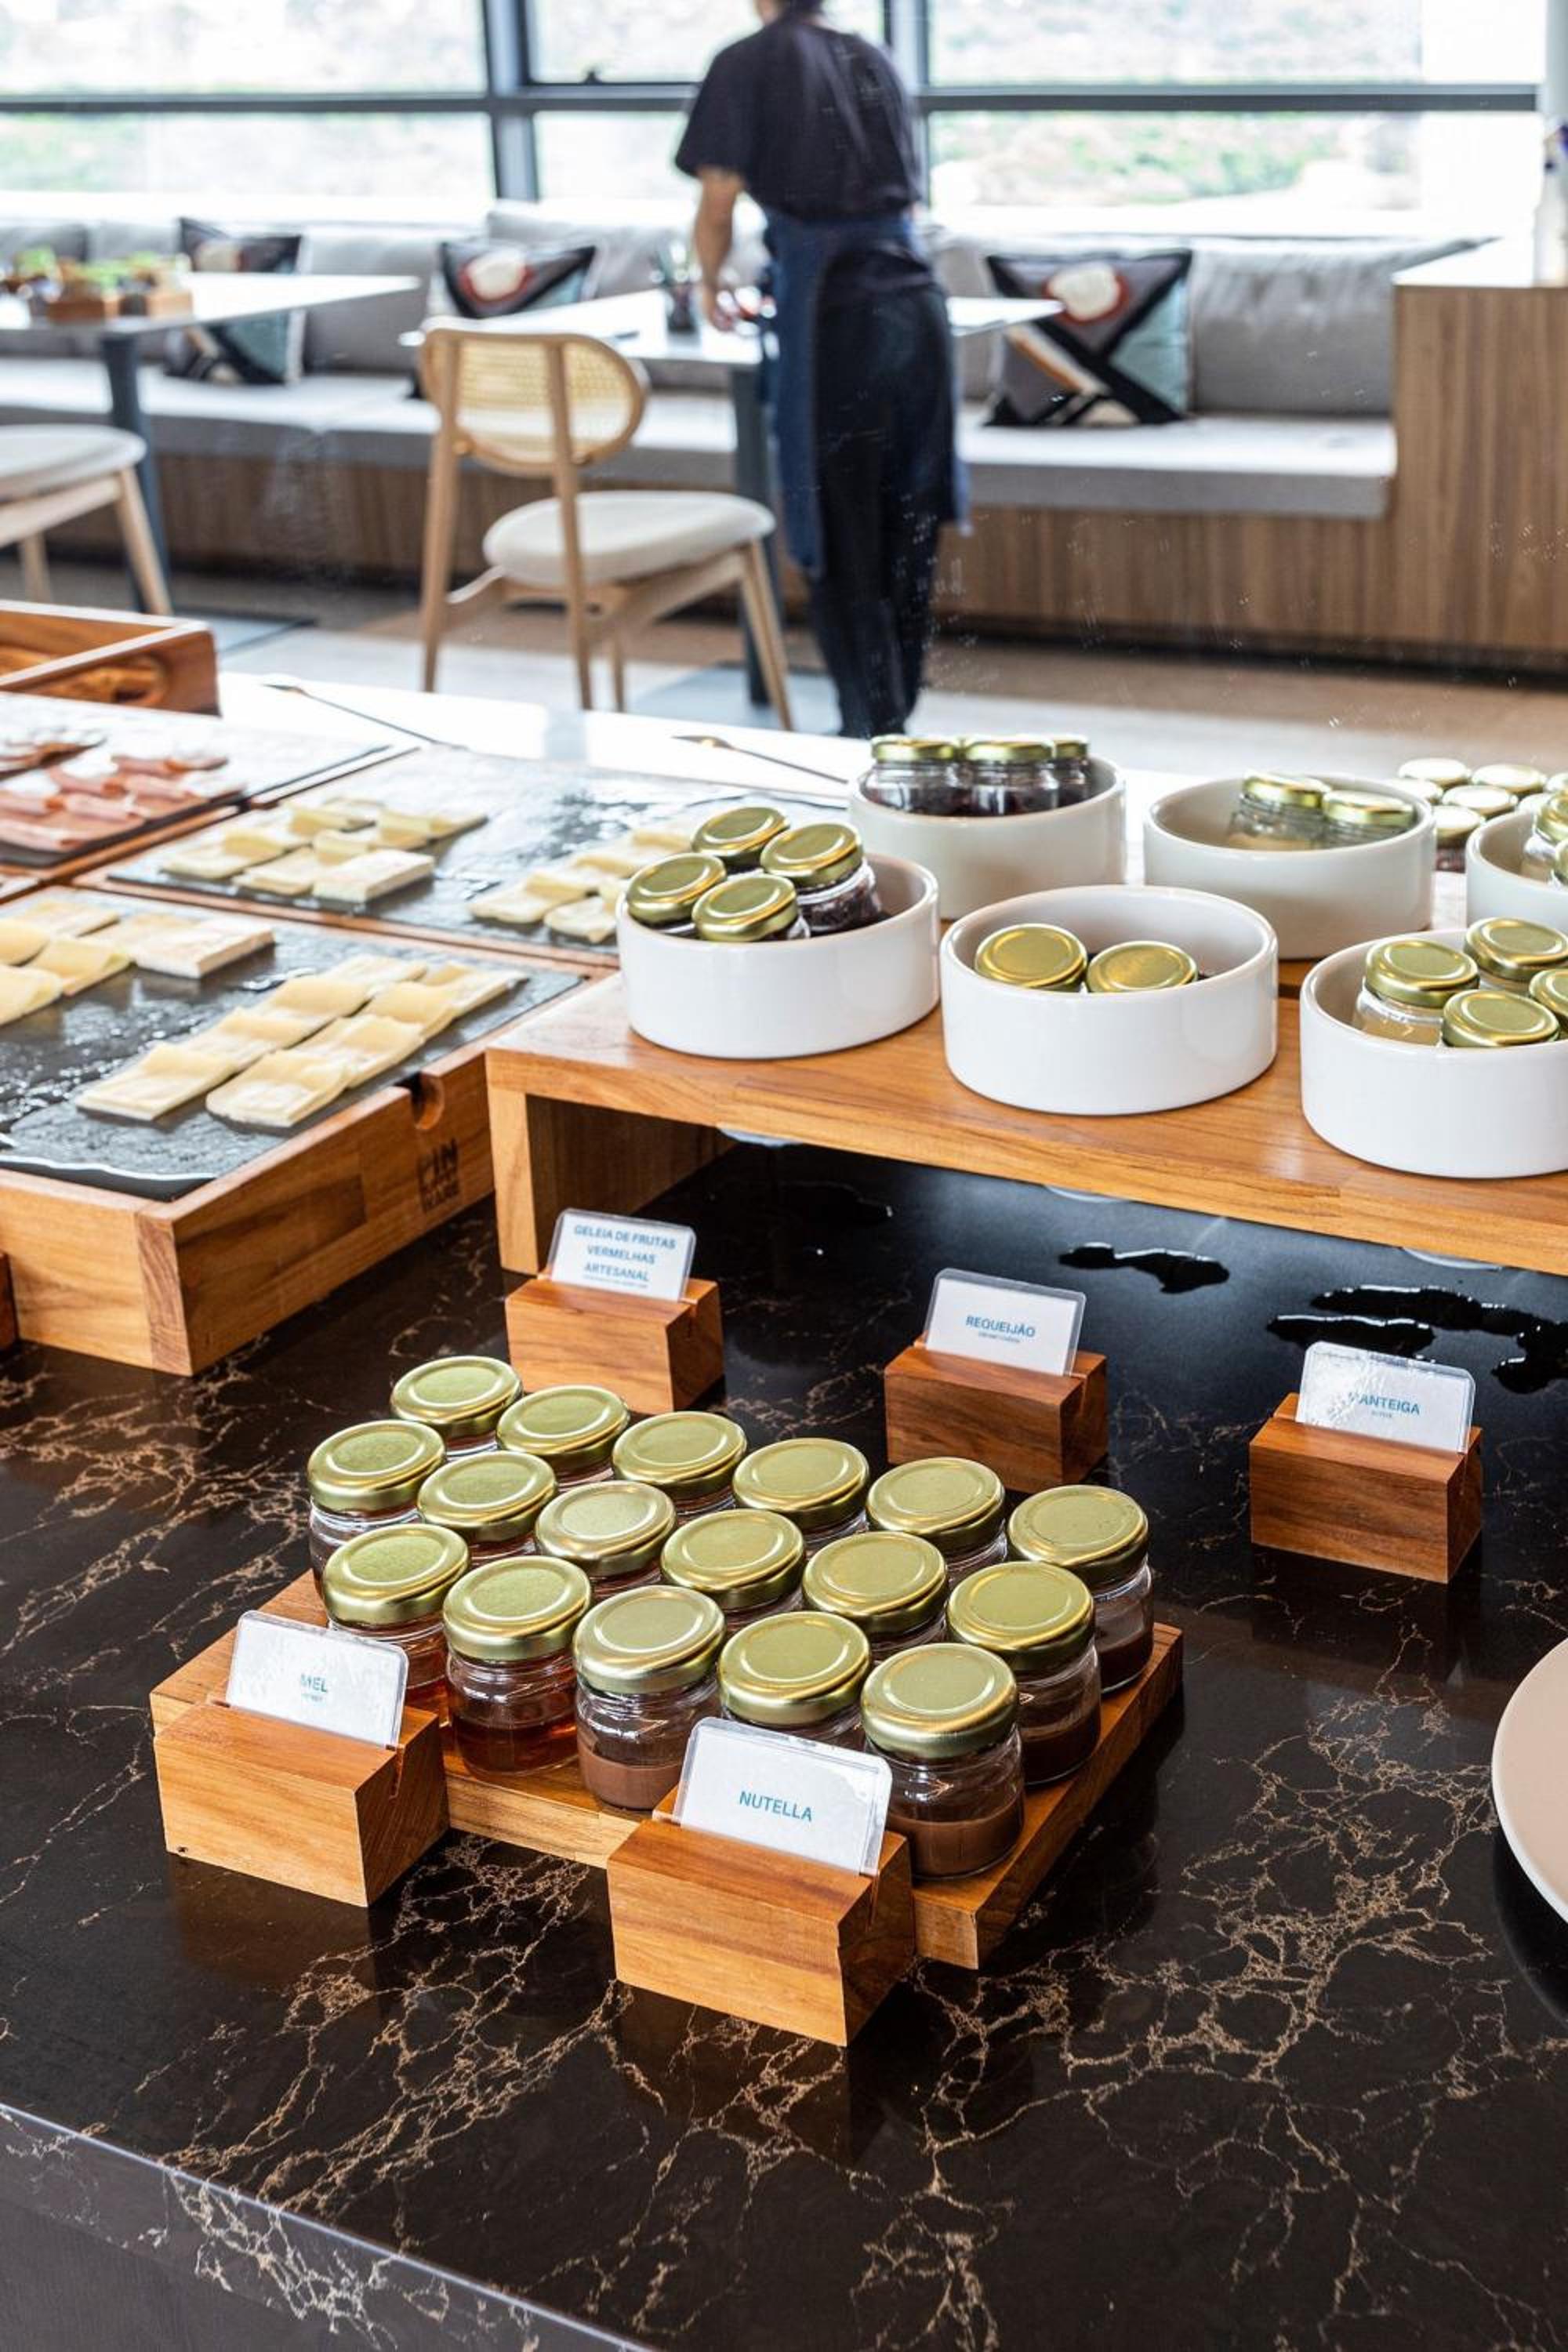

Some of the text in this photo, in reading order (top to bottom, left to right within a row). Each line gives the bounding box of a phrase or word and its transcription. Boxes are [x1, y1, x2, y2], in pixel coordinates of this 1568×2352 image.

[575, 1225, 677, 1250] GELEIA DE FRUTAS
[586, 1245, 656, 1264] VERMELHAS
[584, 1262, 650, 1281] ARTESANAL
[965, 1315, 1036, 1338] REQUEIJÃO
[739, 1791, 813, 1821] NUTELLA
